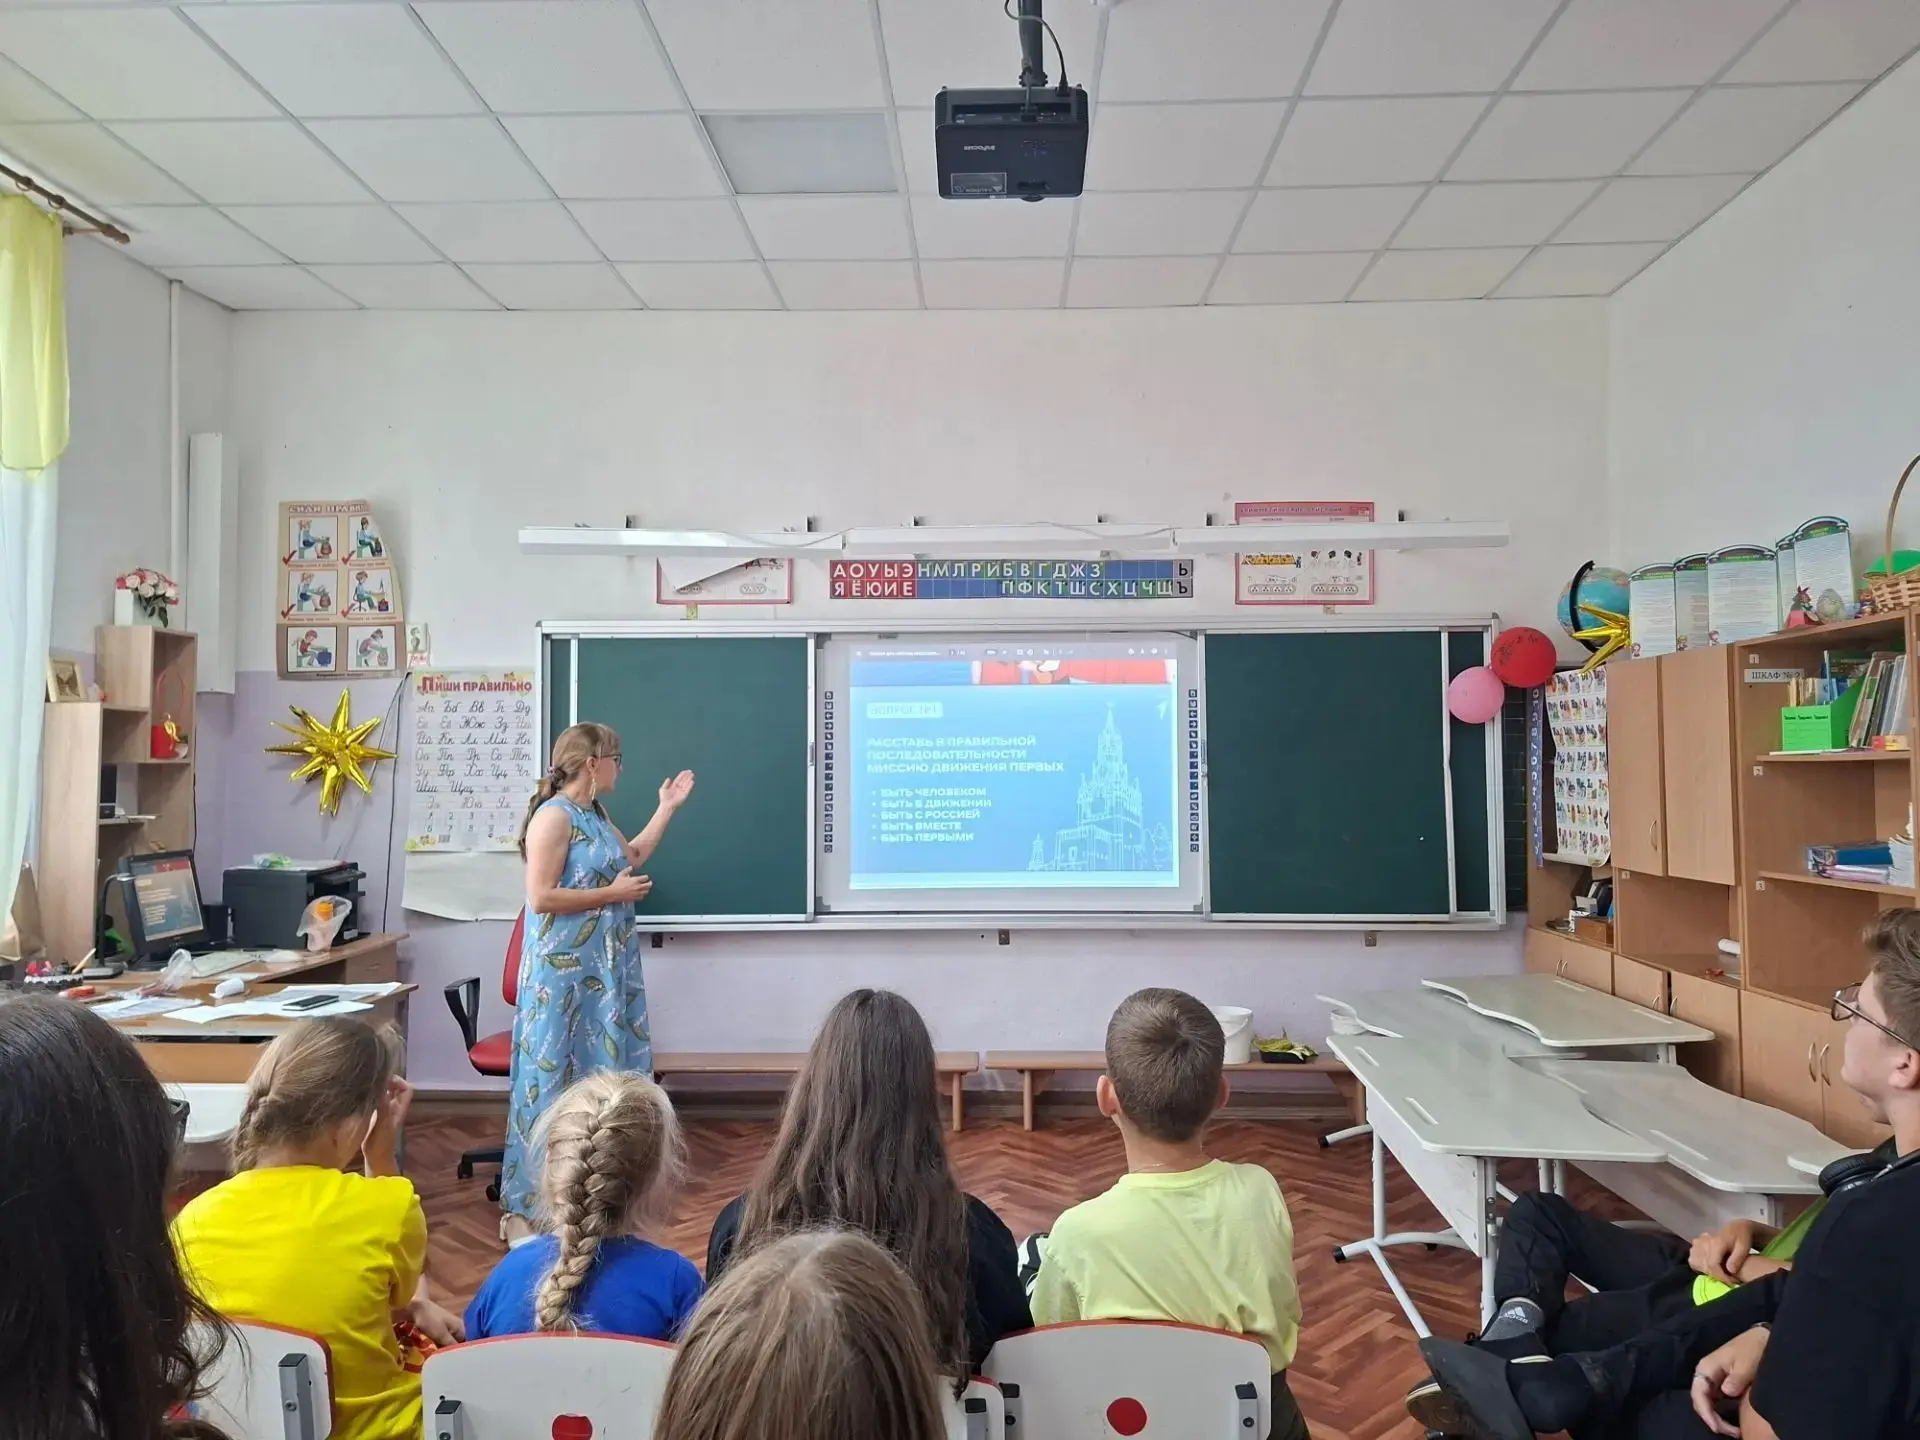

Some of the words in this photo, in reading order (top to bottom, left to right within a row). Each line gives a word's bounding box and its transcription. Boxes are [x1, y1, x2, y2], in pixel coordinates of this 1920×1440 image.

[1751, 671, 1781, 680] ШКАФ
[463, 680, 533, 692] ПРАВИЛЬНО
[867, 738, 934, 748] РАССТАВЬ
[947, 734, 1037, 747] ПРАВИЛЬНОЙ
[867, 750, 1027, 760] ПОСЛЕДОВАТЕЛЬНОСТИ
[867, 763, 929, 773] МИССИЮ
[931, 762, 1008, 774] ДВИЖЕНИЯ
[1010, 761, 1065, 772] ПЕРВЫХ
[881, 788, 913, 797] БЫТЬ
[915, 787, 987, 796] ЧЕЛОВЕКОМ
[881, 800, 913, 808] БЫТЬ
[925, 799, 992, 809] ДВИЖЕНИИ
[881, 811, 913, 820] БЫТЬ
[915, 811, 923, 819] С
[925, 809, 981, 819] РОССИЕЙ
[881, 823, 913, 831] БЫТЬ
[915, 822, 962, 831] ВМЕСТЕ
[881, 834, 913, 843] БЫТЬ
[915, 833, 975, 842] ПЕРВЫМИ
